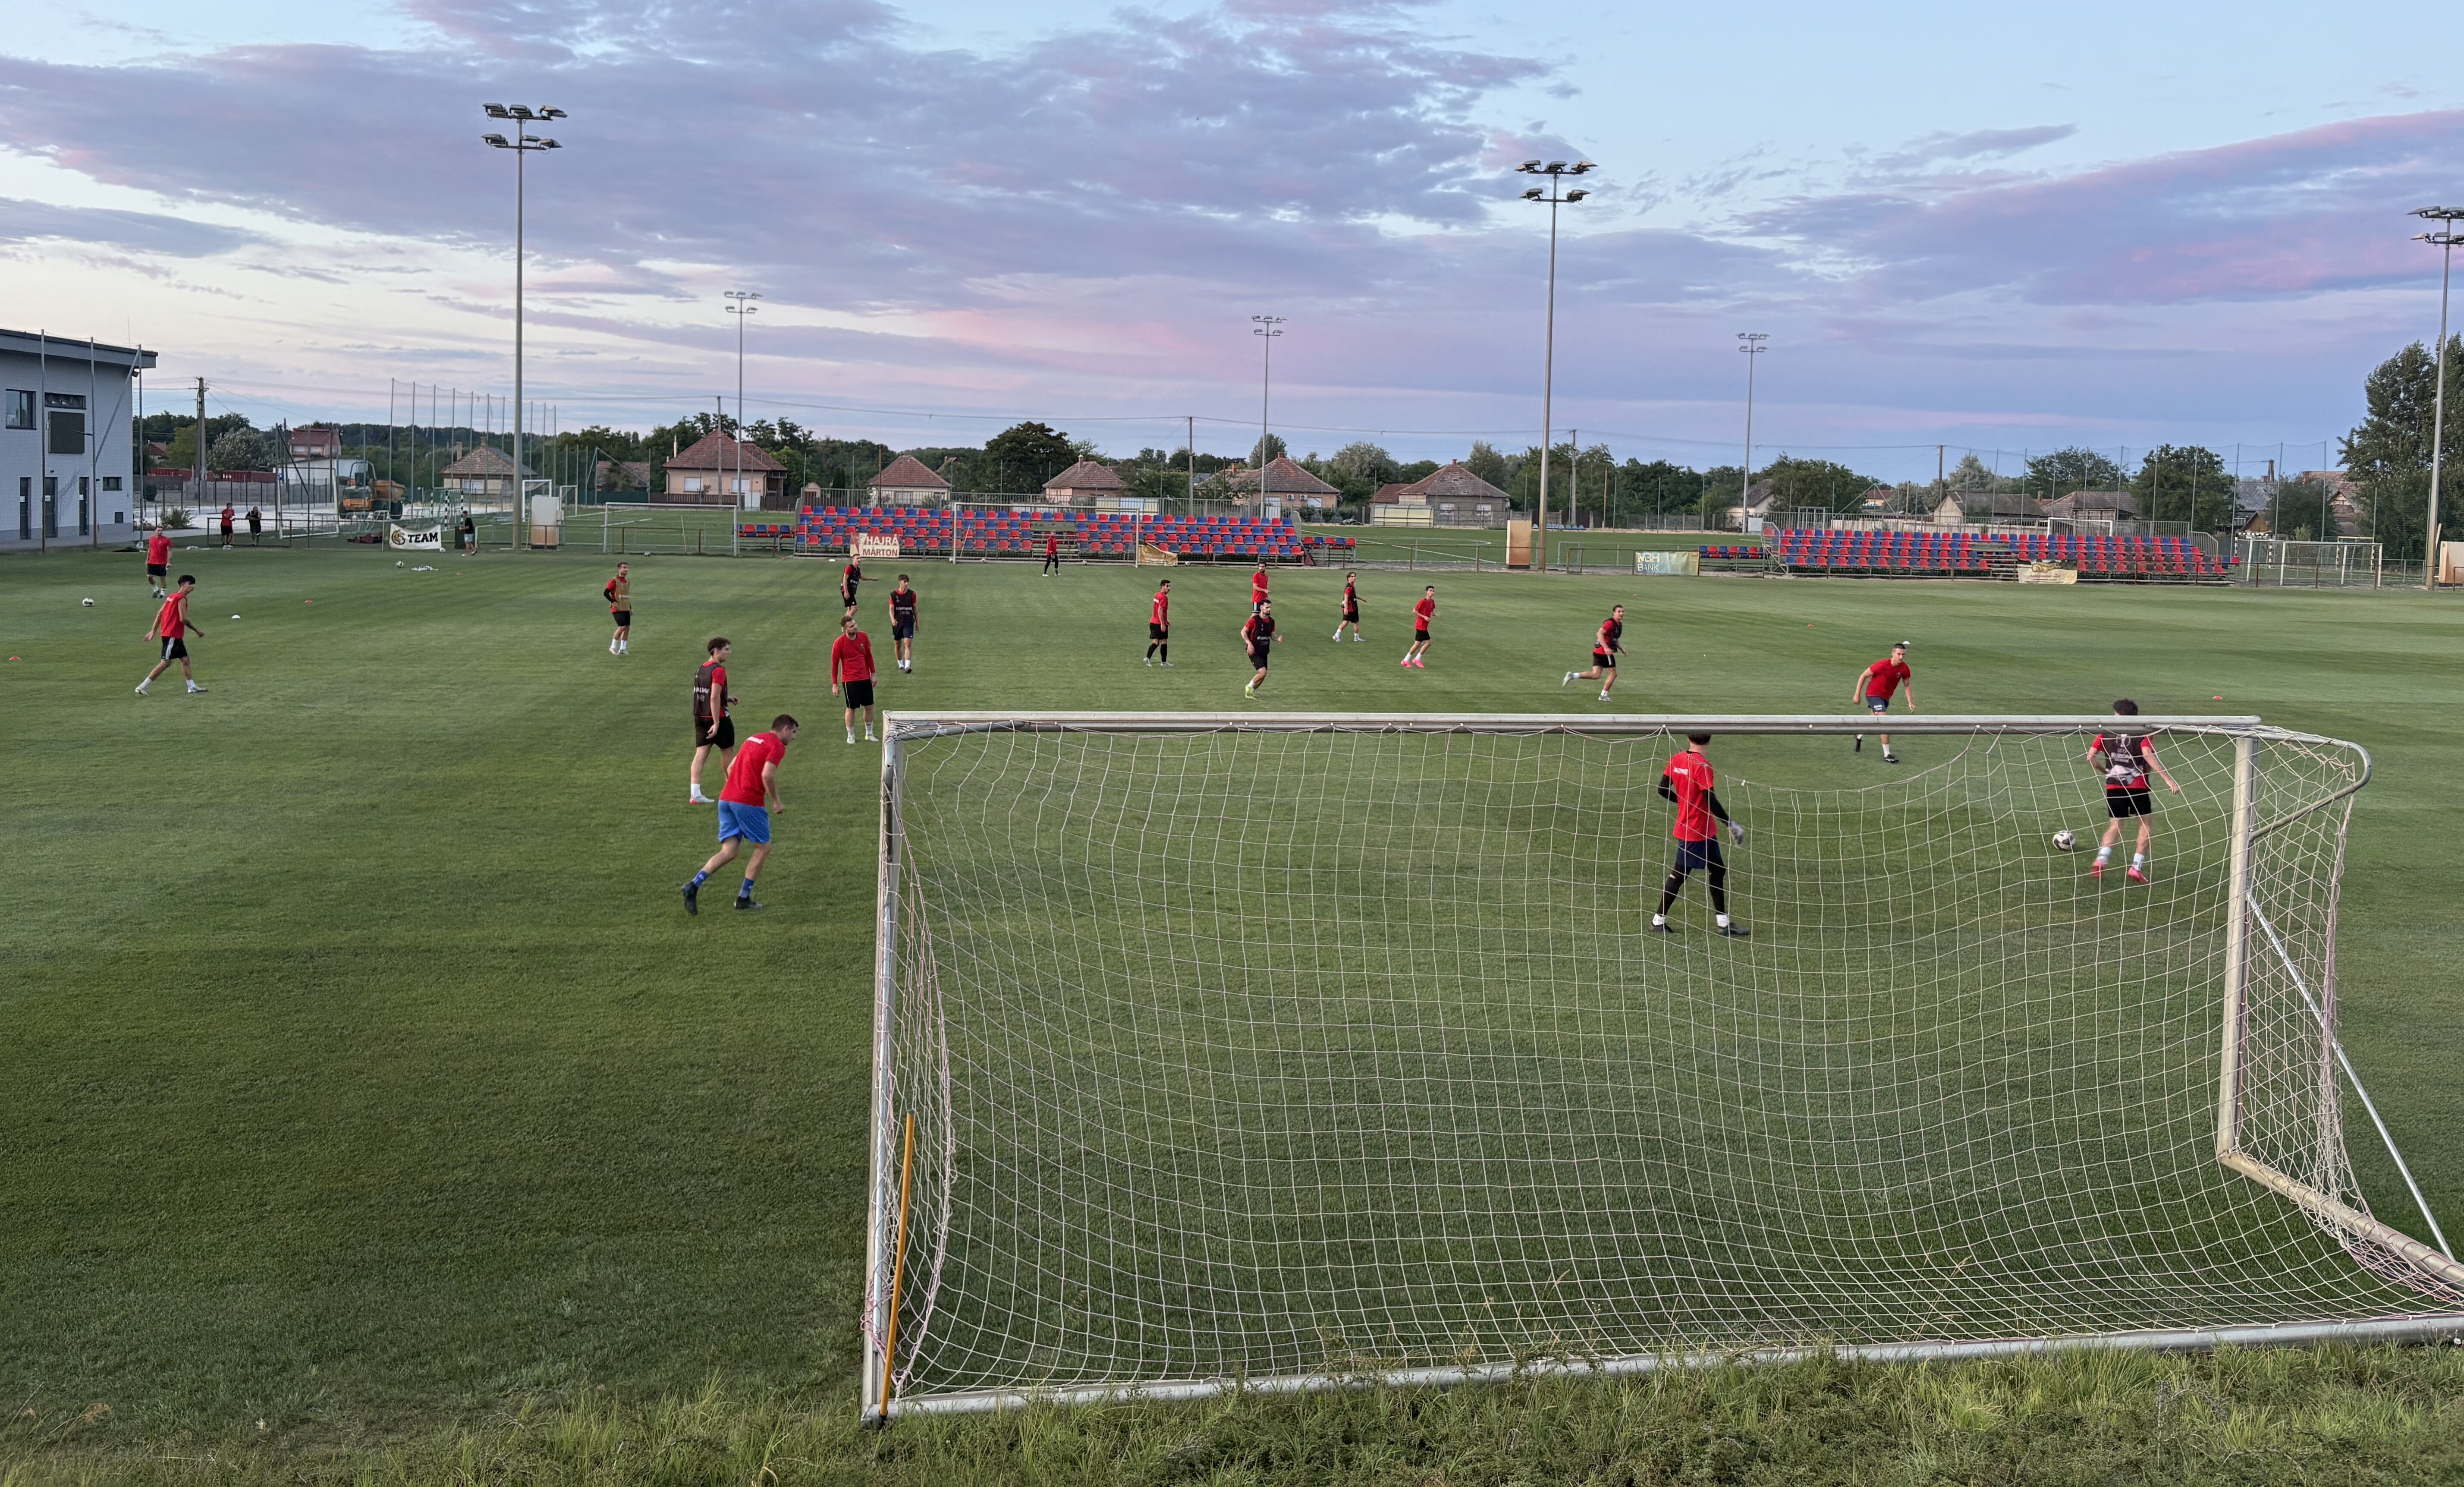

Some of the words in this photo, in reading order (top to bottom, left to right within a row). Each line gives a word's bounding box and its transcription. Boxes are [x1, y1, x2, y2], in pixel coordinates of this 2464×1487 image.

[408, 532, 438, 543] TEAM
[866, 534, 899, 545] HAJRÁ
[863, 546, 898, 556] MÁRTON
[1637, 552, 1660, 563] MBH
[1637, 563, 1659, 573] BANK
